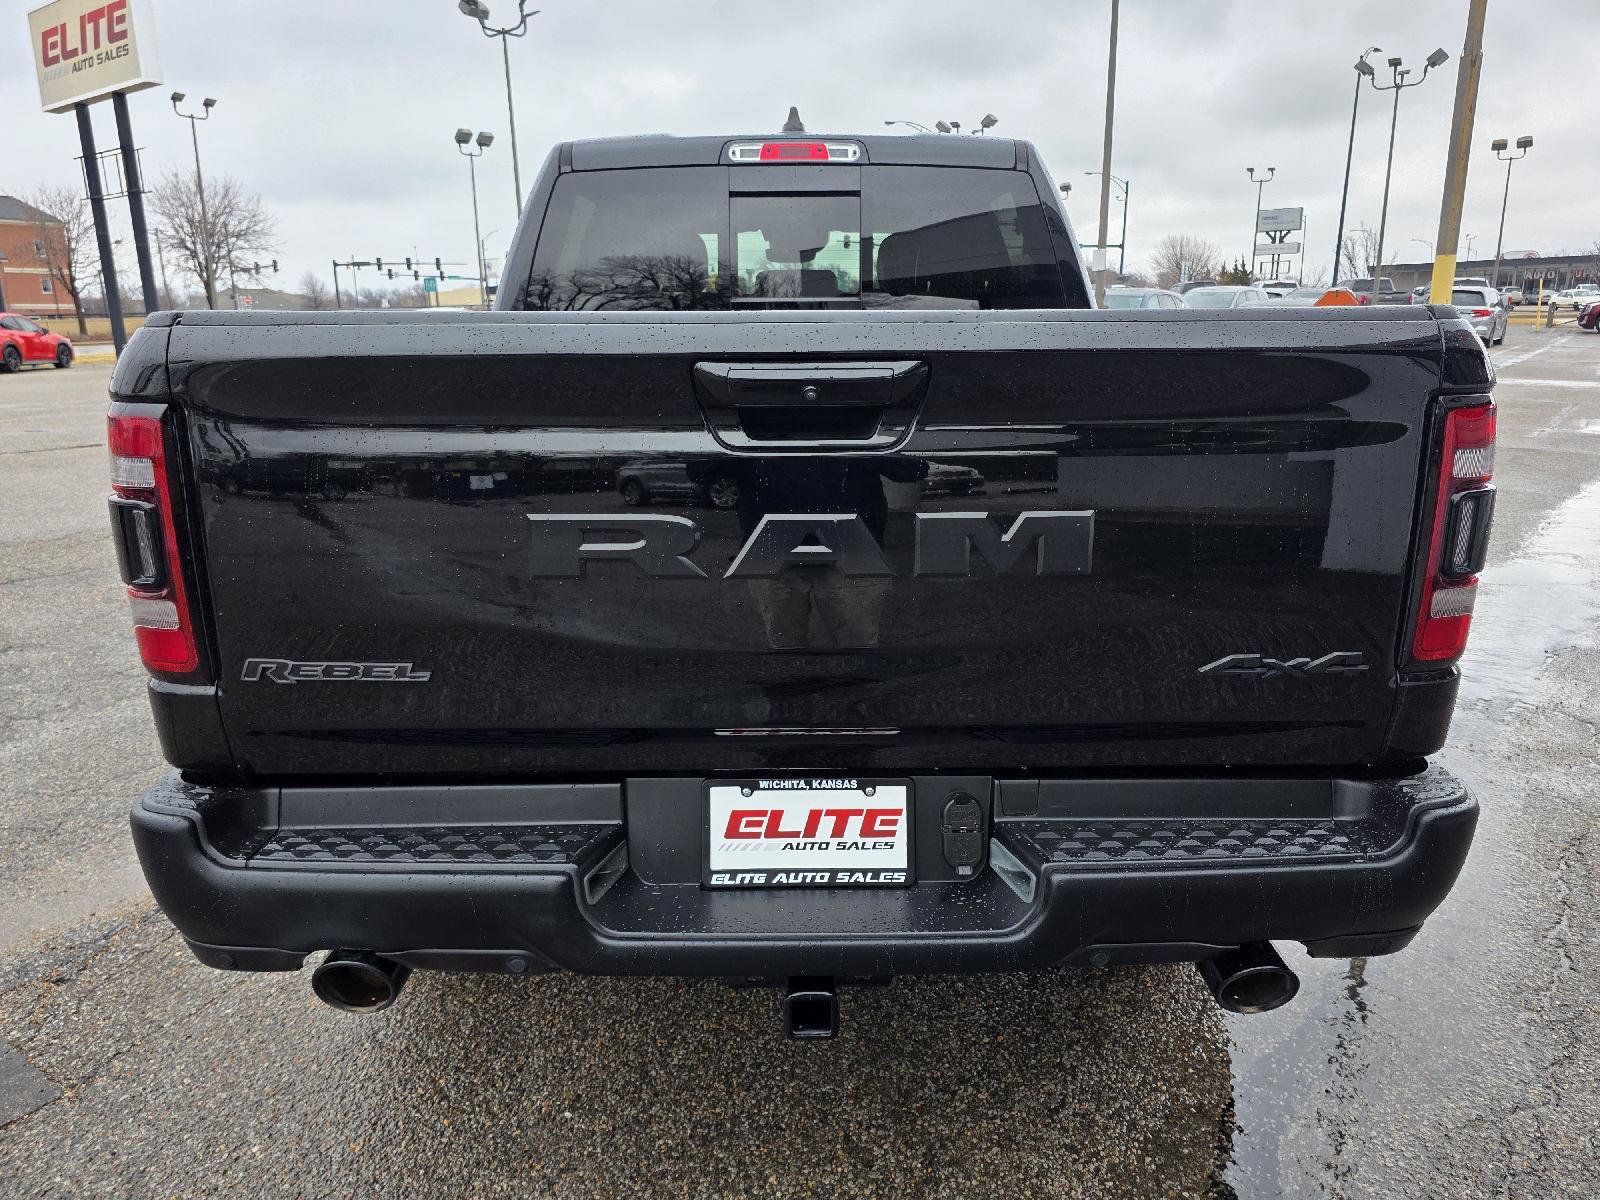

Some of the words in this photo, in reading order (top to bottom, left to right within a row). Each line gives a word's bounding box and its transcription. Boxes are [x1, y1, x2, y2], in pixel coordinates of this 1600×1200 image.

[41, 0, 129, 68] ELITE
[71, 56, 94, 74] AUTO
[96, 43, 130, 66] SALES
[526, 509, 1096, 579] RAM
[240, 658, 432, 684] REBEL
[758, 779, 810, 791] WICHITA,
[812, 779, 858, 789] KANSAS
[723, 808, 904, 839] ELITE
[781, 841, 831, 851] AUTO
[835, 841, 896, 851] SALES
[710, 873, 768, 885] ELITE
[771, 872, 831, 884] AUTO
[835, 872, 907, 883] SALES
